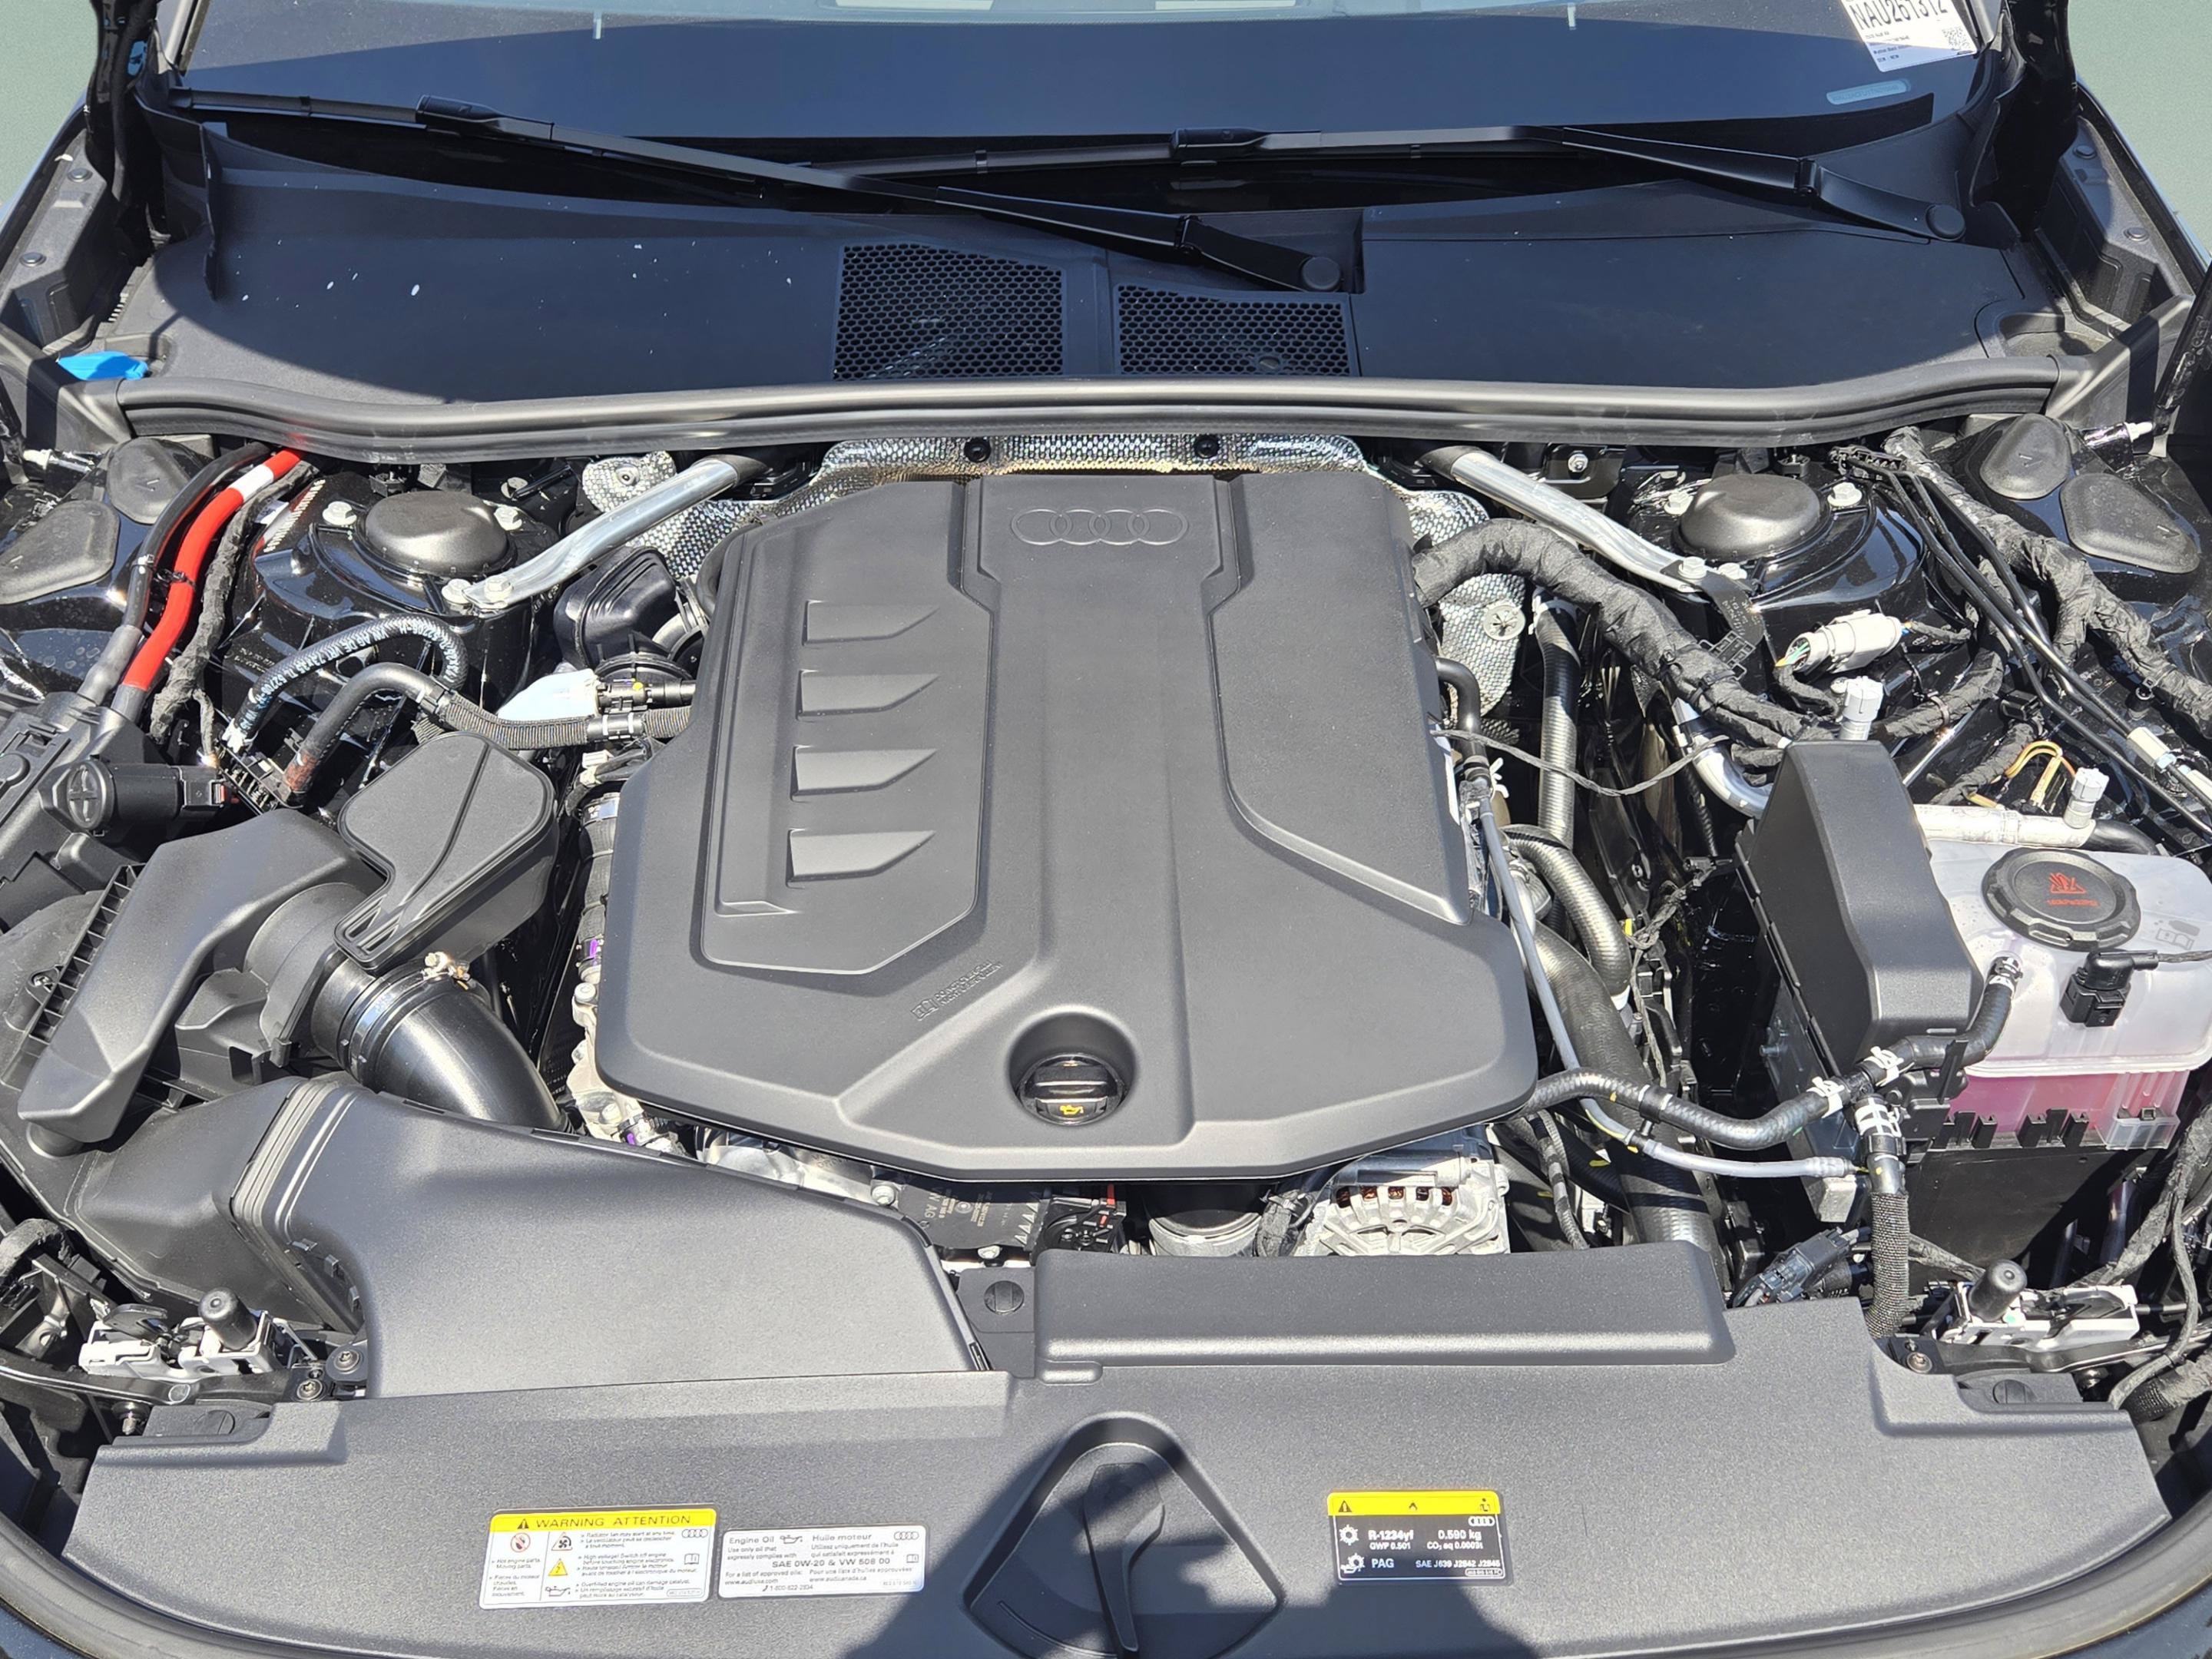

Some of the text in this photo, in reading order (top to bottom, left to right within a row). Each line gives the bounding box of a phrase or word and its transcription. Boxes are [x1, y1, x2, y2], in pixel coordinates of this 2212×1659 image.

[537, 1515, 691, 1528] WARNING ATTENTION
[1368, 1529, 1414, 1541] R-1234yf
[1469, 1529, 1482, 1541] kg
[1369, 1541, 1411, 1550] GWP 0.501
[1372, 1558, 1395, 1568] PAG
